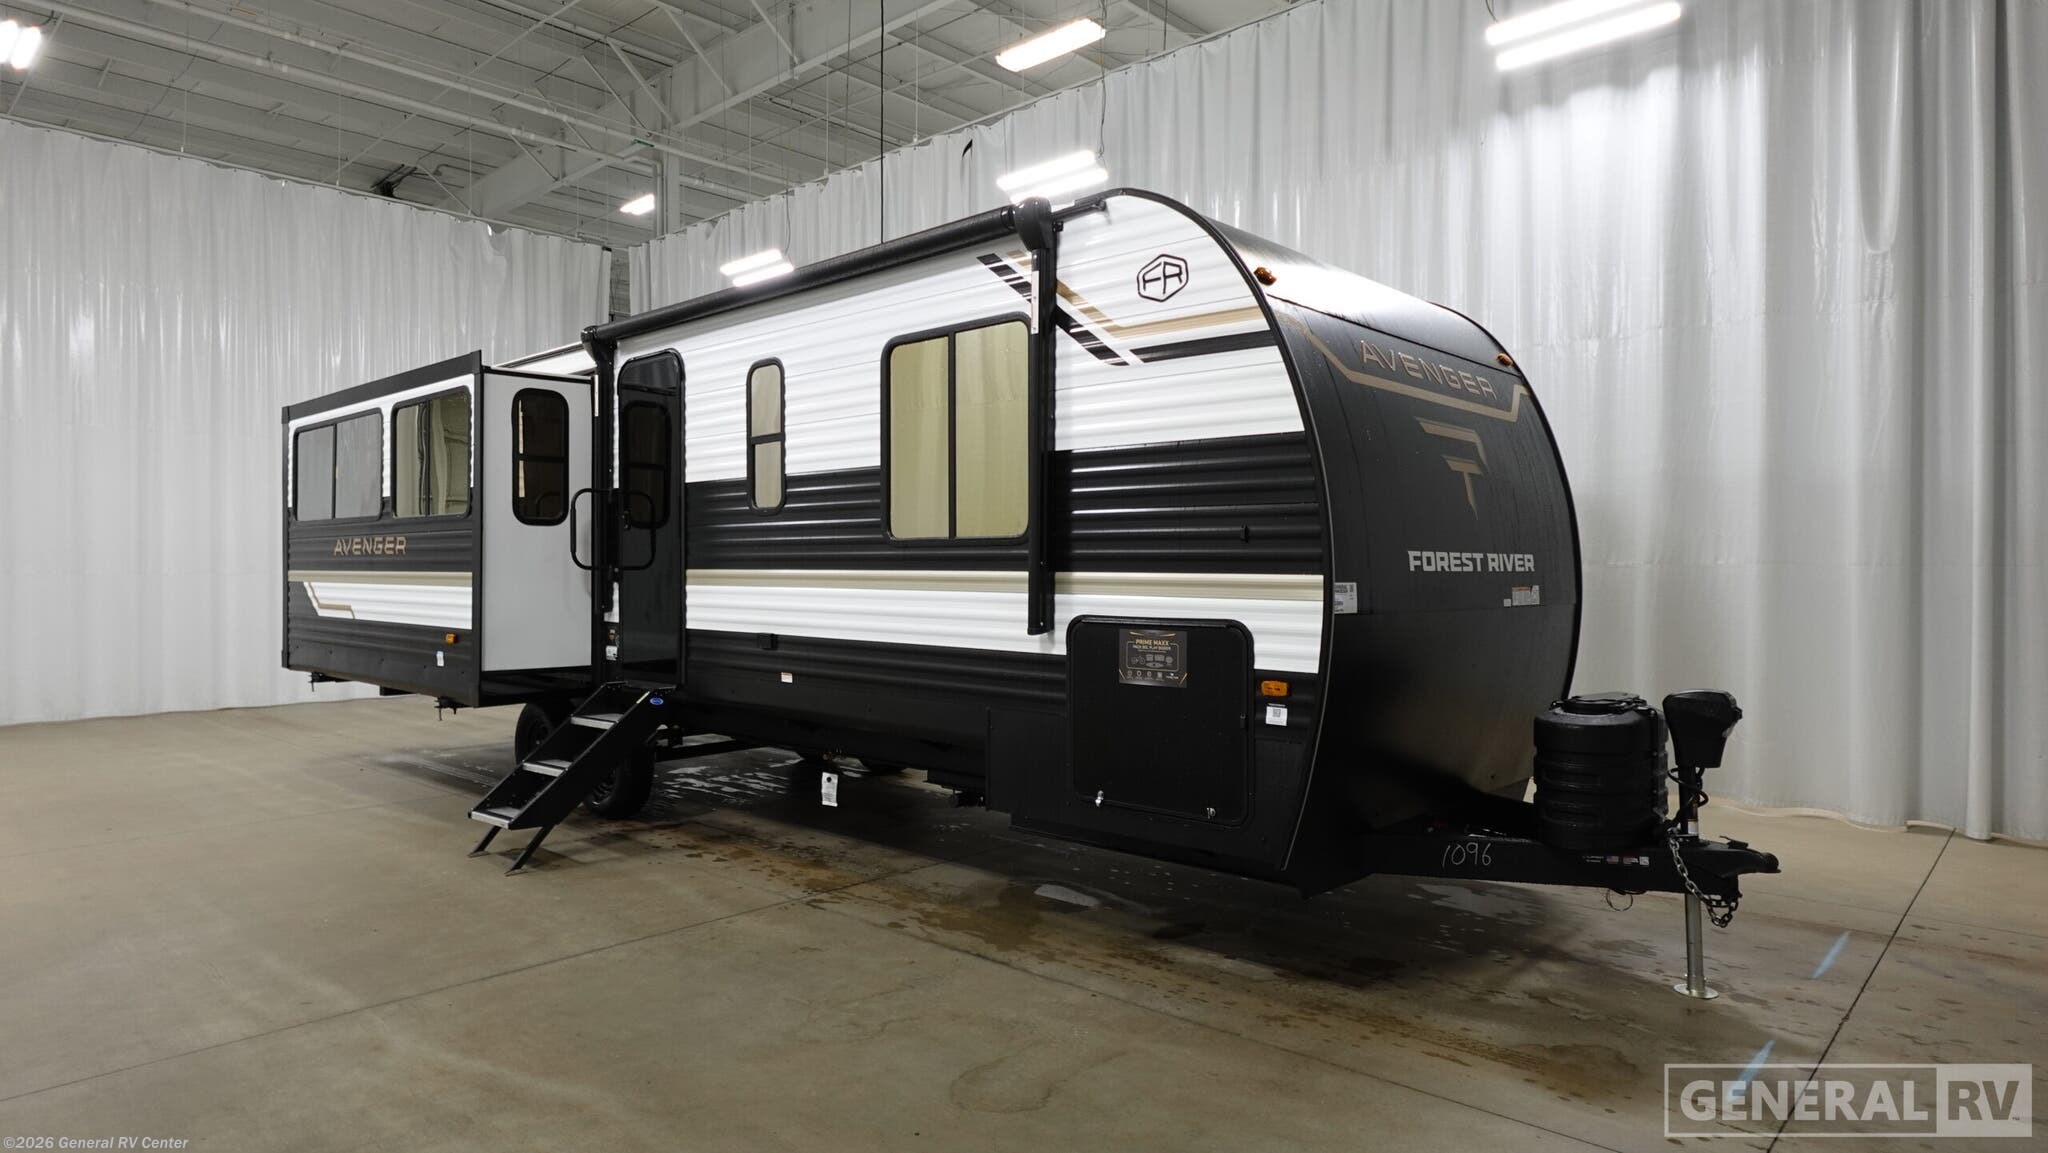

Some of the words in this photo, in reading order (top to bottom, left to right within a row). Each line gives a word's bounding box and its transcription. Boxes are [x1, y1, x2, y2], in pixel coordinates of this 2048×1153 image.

[1360, 340, 1497, 400] AVENGER
[333, 537, 408, 556] AVENGER
[1408, 551, 1484, 572] FOREST
[1486, 553, 1535, 572] RIVER
[1442, 842, 1492, 868] 1096
